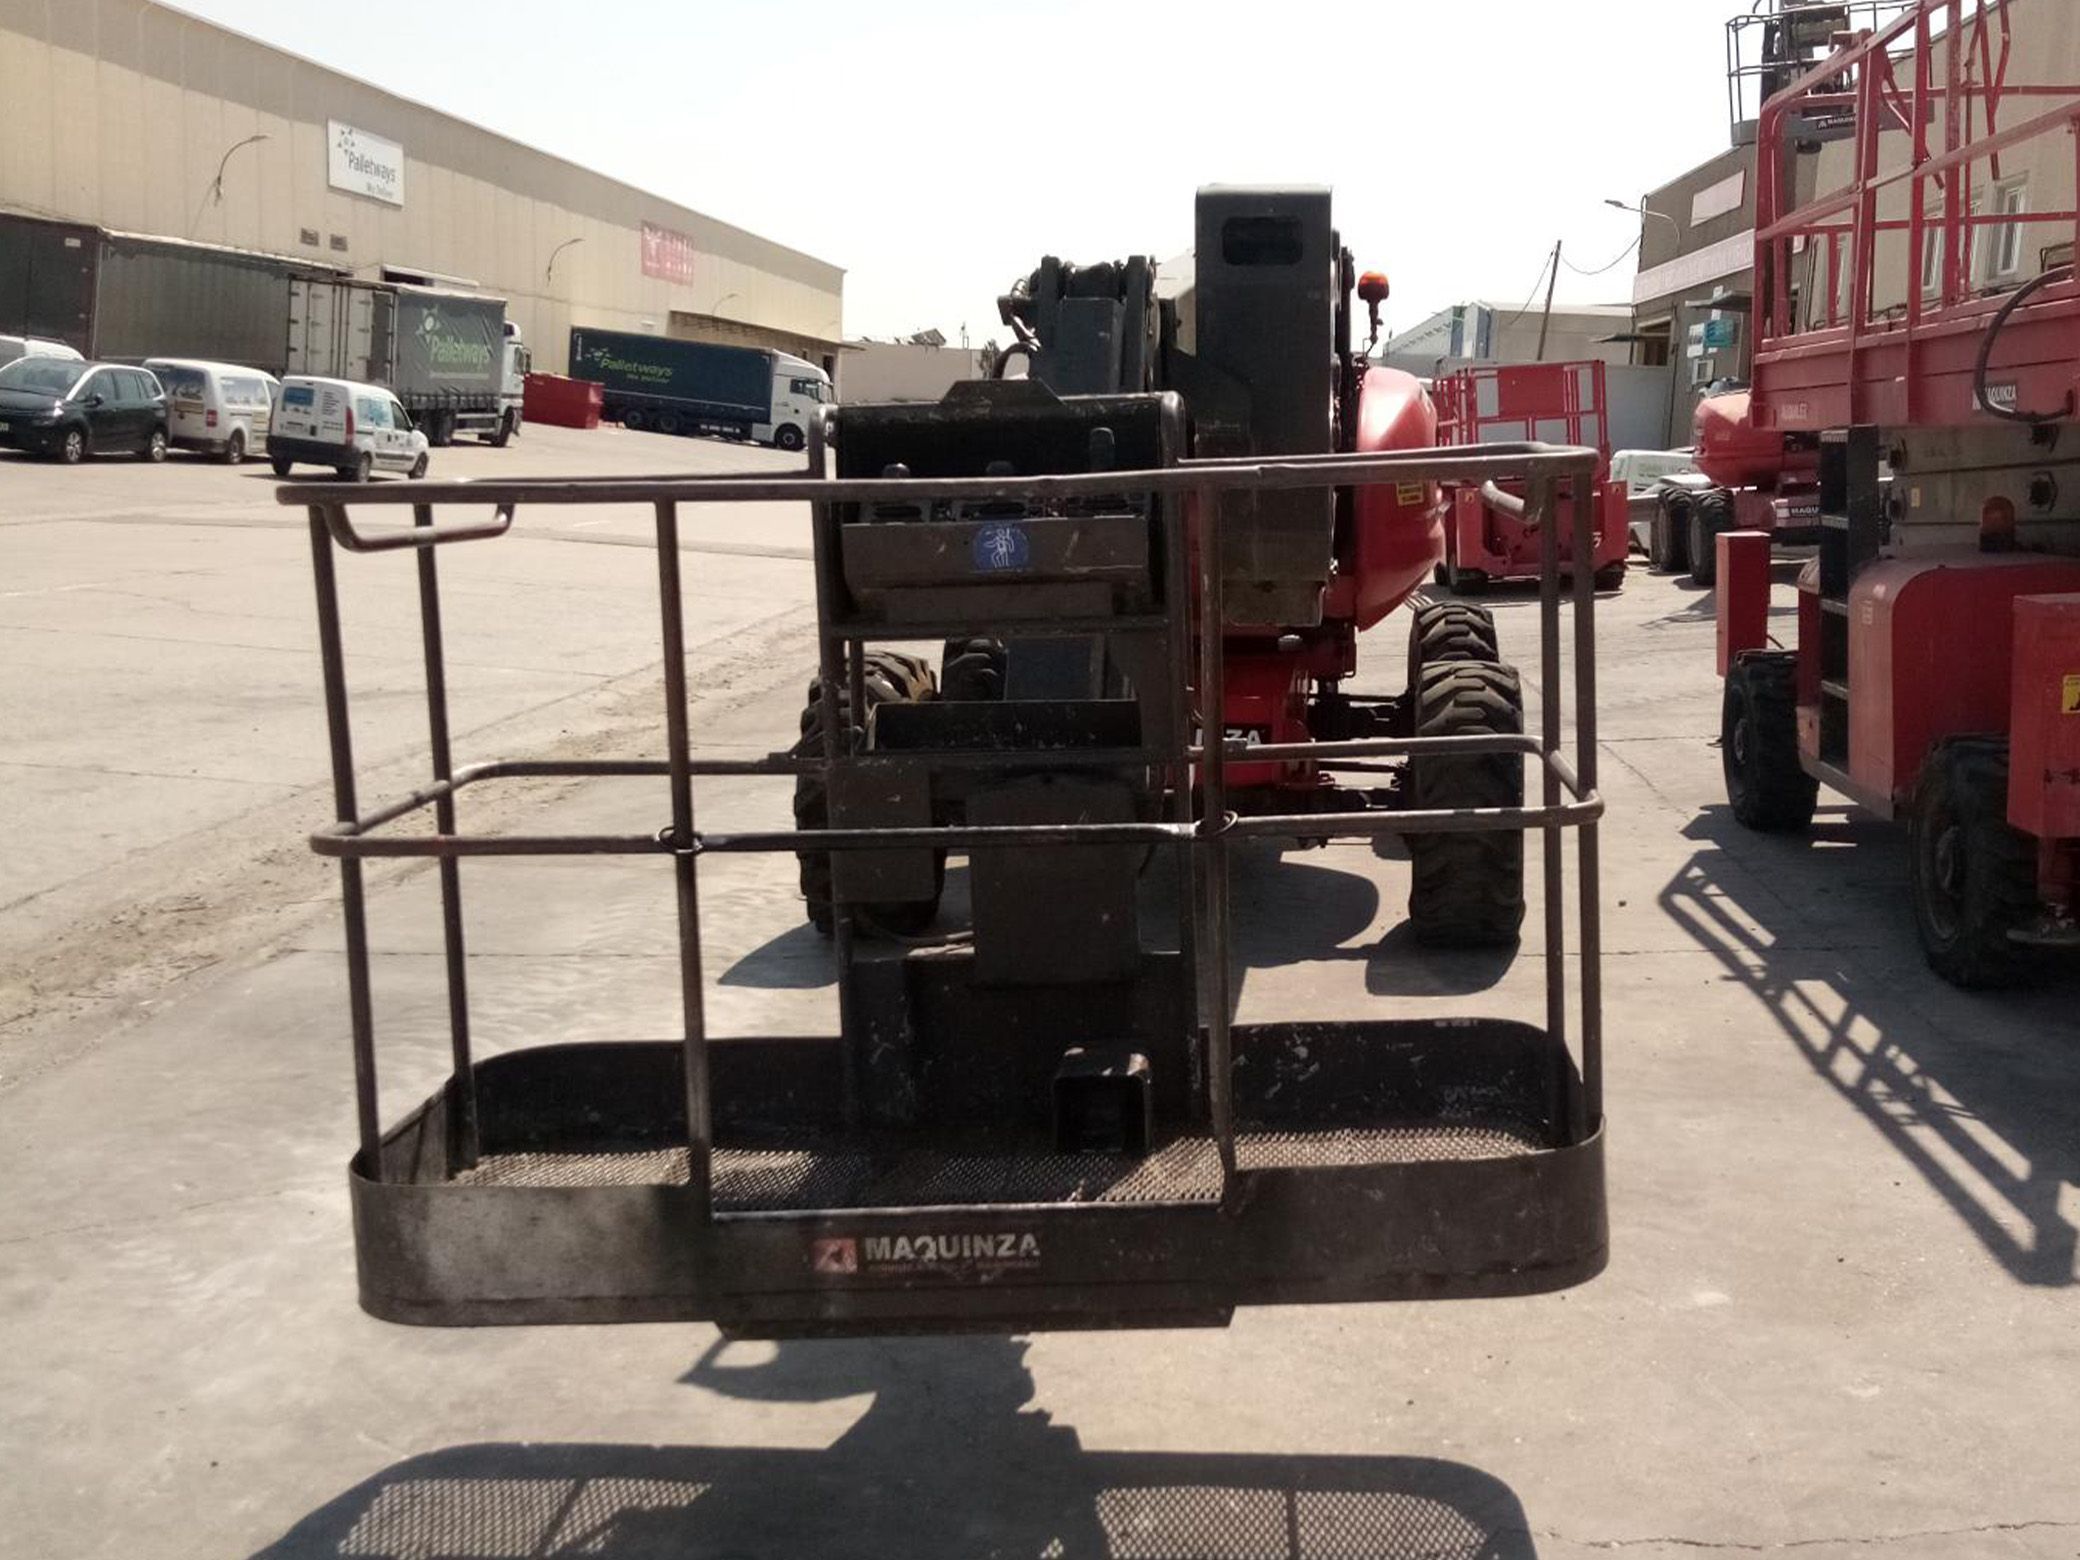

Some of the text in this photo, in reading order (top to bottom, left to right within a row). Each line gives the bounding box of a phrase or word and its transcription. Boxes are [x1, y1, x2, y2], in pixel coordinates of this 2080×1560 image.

[348, 151, 396, 184] Palletways
[430, 334, 490, 369] Palletways
[600, 358, 672, 377] Palletways
[864, 1232, 1041, 1262] MAQUINZA
